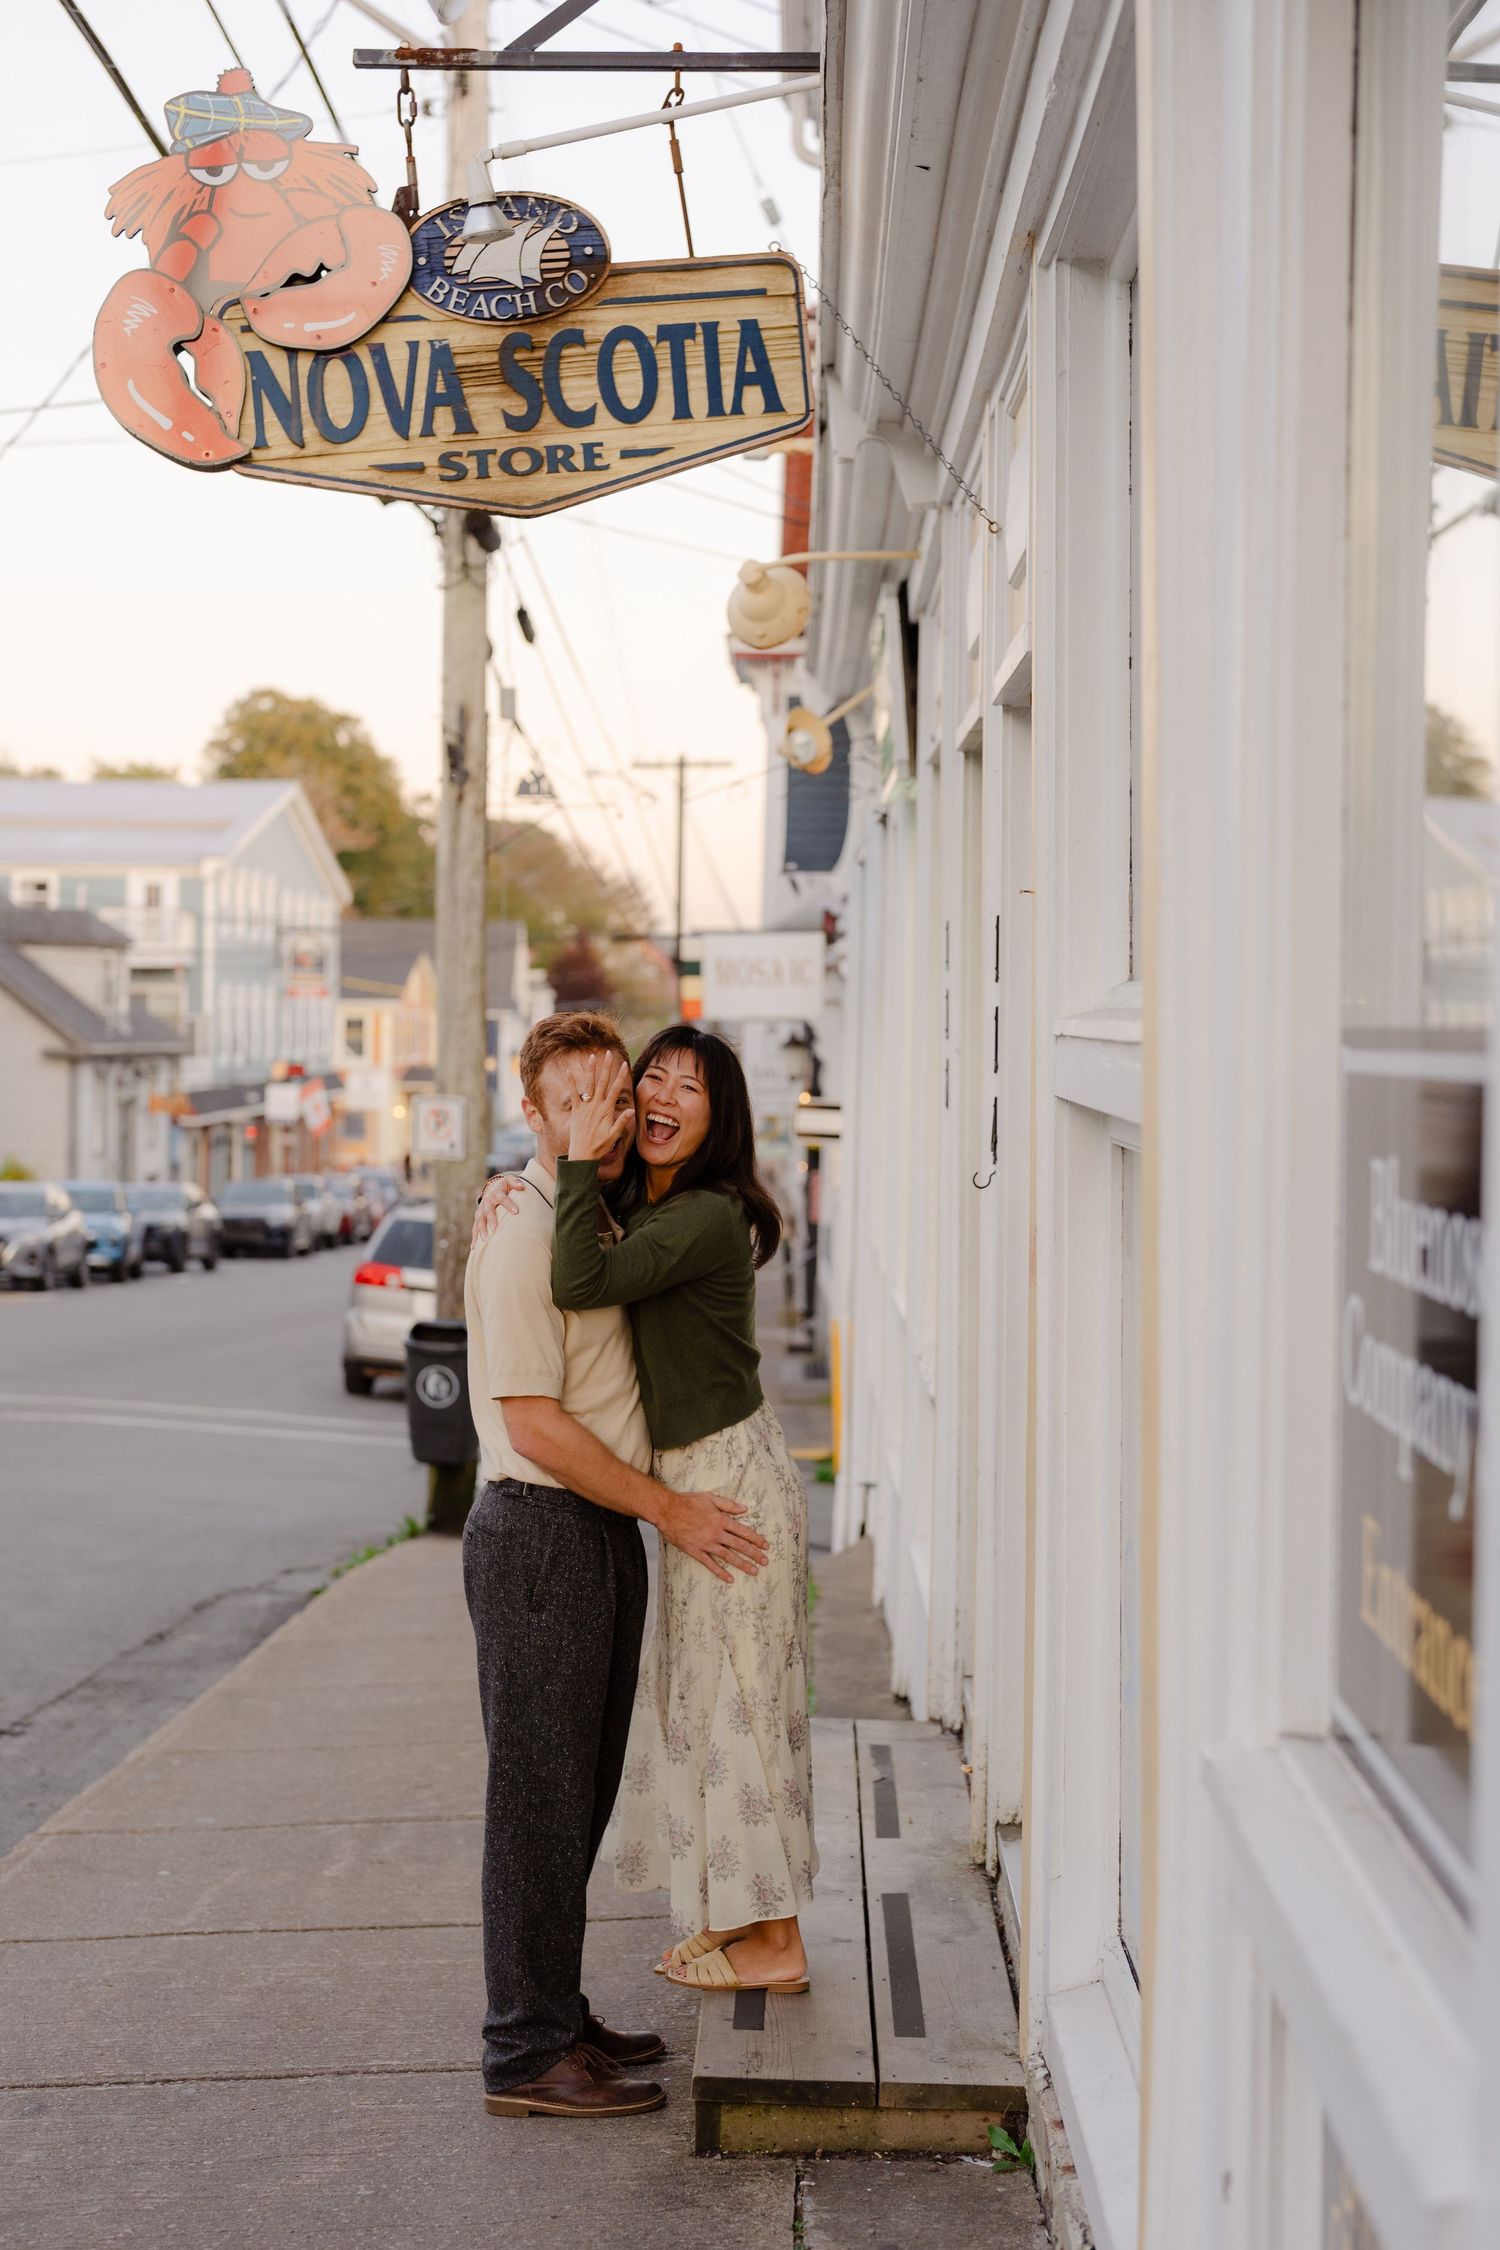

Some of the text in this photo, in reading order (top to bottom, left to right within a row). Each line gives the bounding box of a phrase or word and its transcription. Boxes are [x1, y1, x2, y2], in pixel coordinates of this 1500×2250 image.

[432, 195, 579, 240] ISAND
[423, 275, 540, 320] BEACH
[248, 318, 785, 449] NOVA SCOTIA
[436, 441, 611, 482] STORE
[713, 957, 816, 988] MOSAIC
